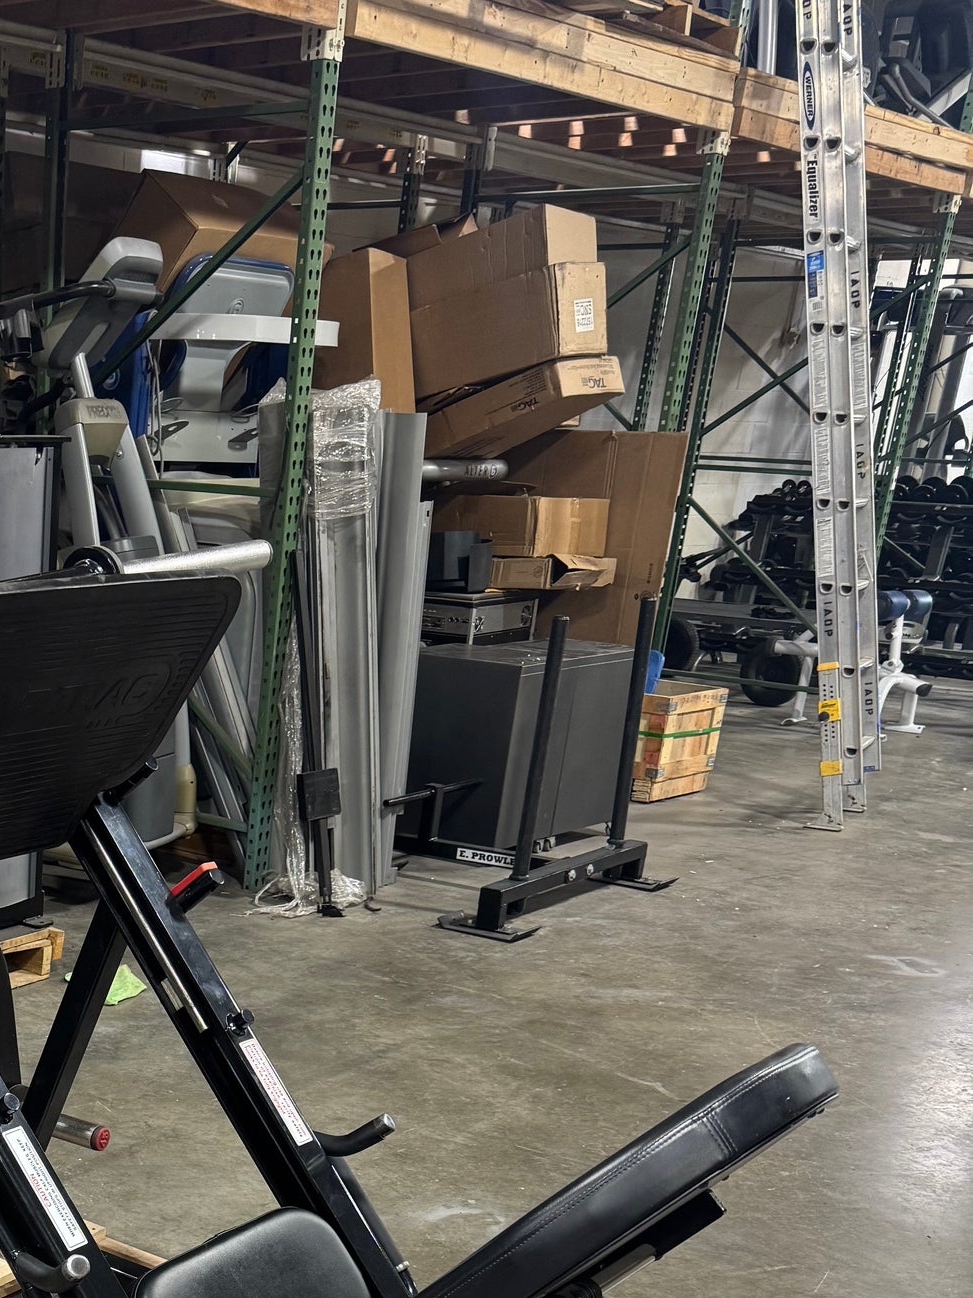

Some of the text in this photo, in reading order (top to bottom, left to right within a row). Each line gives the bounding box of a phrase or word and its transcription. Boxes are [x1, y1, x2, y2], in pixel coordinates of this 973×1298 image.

[806, 76, 814, 117] WERNER
[807, 160, 819, 218] Equalizer
[459, 850, 469, 859] E.
[29, 1173, 51, 1206] CAUTION
